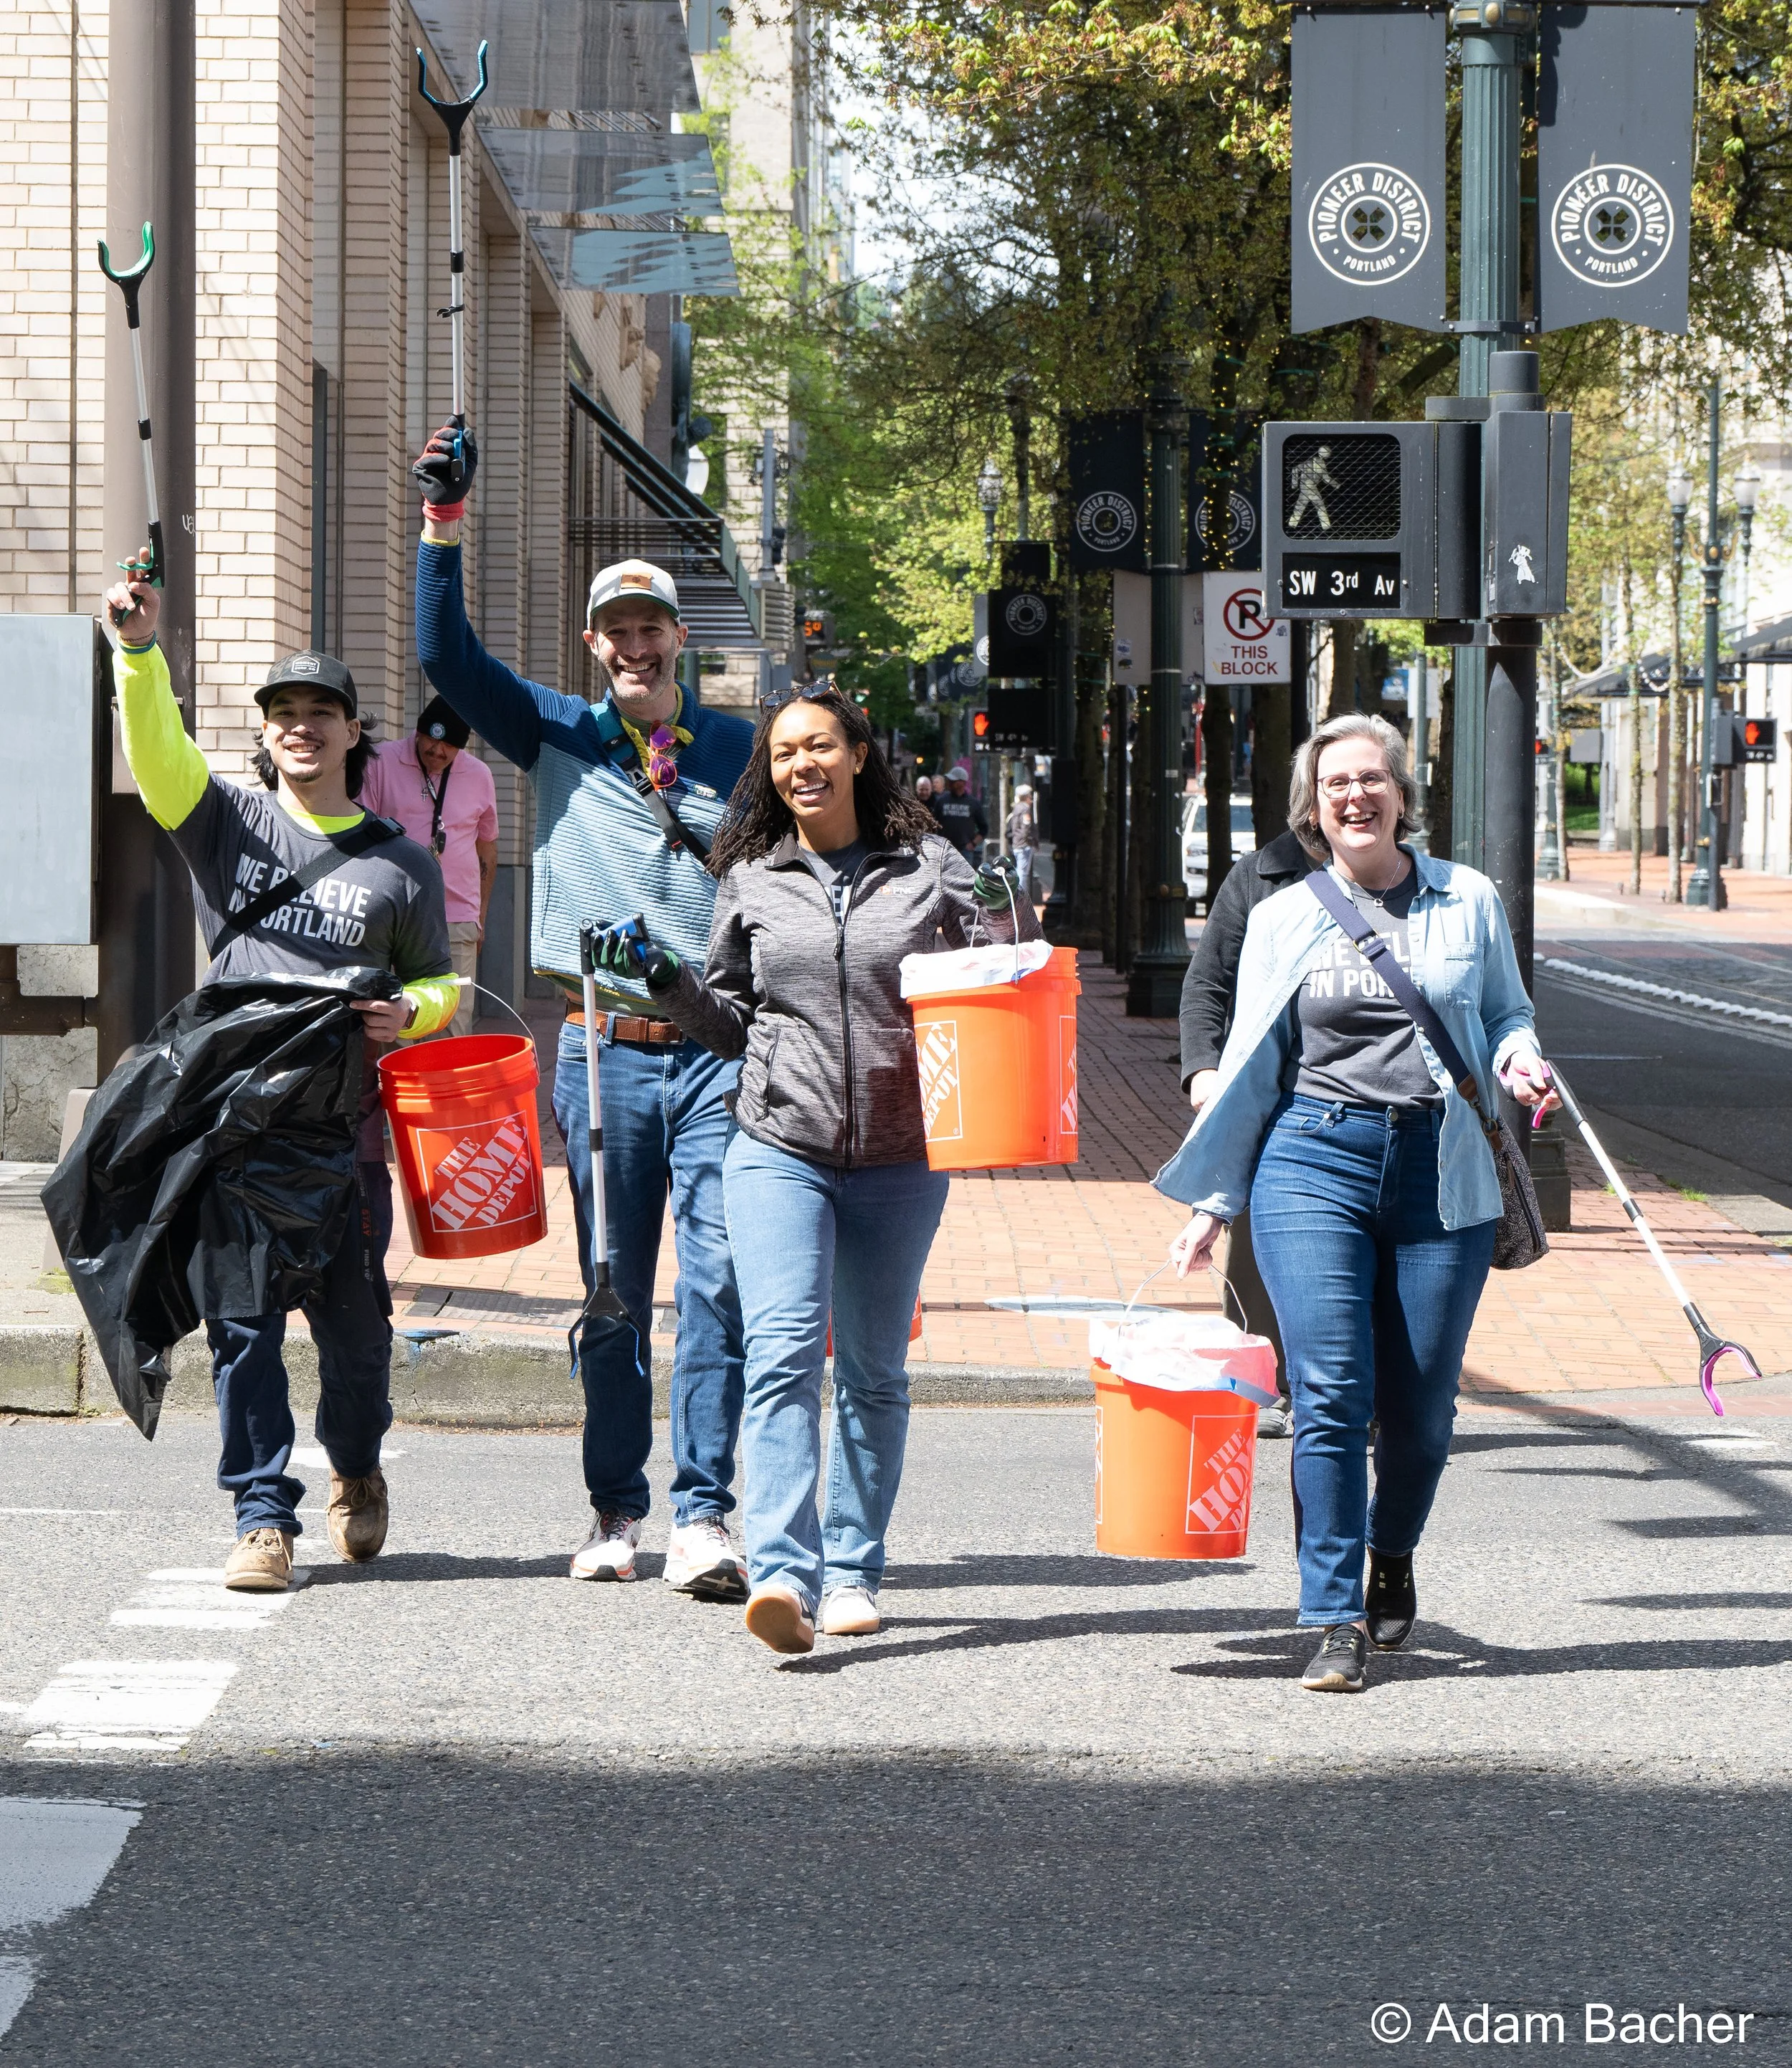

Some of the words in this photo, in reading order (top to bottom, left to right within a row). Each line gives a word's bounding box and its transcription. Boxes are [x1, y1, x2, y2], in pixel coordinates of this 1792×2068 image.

[1317, 173, 1366, 243] PIONEER
[1372, 172, 1422, 244] DISTRICT
[1560, 174, 1610, 243] PIONEER
[1616, 173, 1666, 247] DISTRICT
[1343, 254, 1396, 272] PORTLAND
[1585, 256, 1639, 274] PORTLAND
[1081, 496, 1105, 531] PIONEER
[1107, 496, 1133, 531] DISTRICT
[1290, 571, 1317, 595] SW
[1330, 571, 1358, 596] 3rd
[1374, 575, 1394, 595] Av
[1221, 662, 1278, 675] BLOCK
[1231, 646, 1267, 659] THIS
[236, 853, 267, 894] WE
[1309, 970, 1335, 998] IN
[431, 1116, 528, 1231] HOME
[434, 1136, 482, 1181] THE
[475, 1151, 530, 1226] DEPOT
[1204, 1427, 1246, 1475] THE
